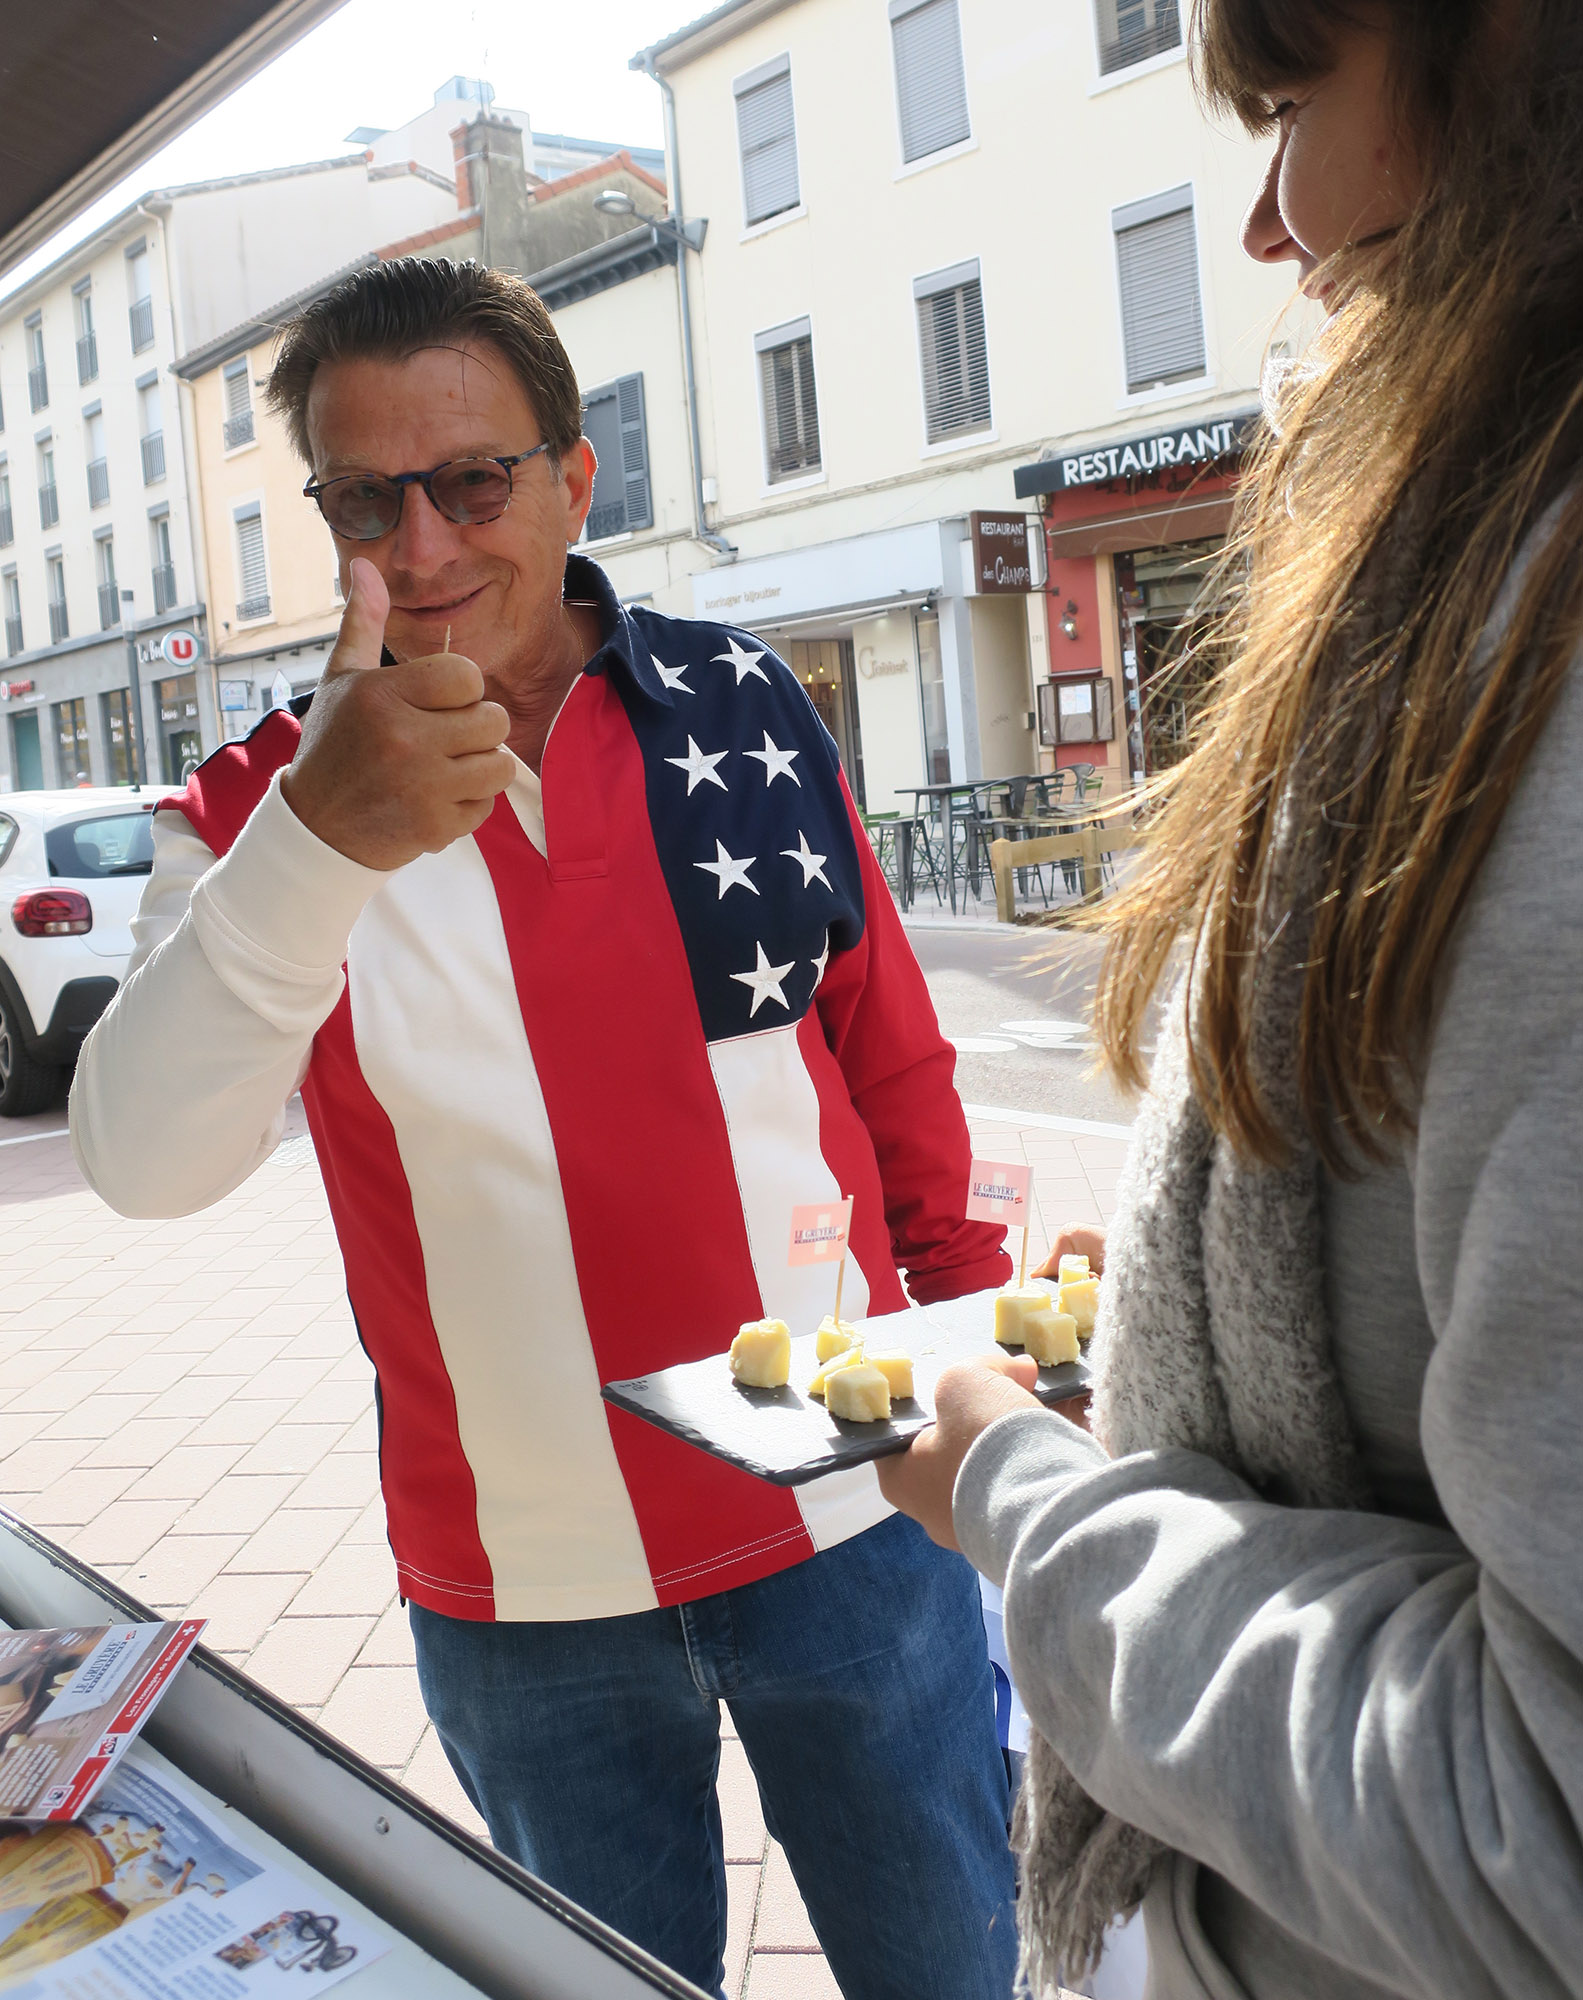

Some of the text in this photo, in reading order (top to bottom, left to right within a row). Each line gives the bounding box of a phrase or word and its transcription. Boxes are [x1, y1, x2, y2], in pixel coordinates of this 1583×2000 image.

[1062, 422, 1234, 486] RESTAURANT
[980, 521, 1025, 536] RESTAURANT
[983, 564, 995, 579] des
[743, 586, 781, 603] bijoutier
[171, 639, 193, 659] U
[973, 1182, 982, 1192] LE
[794, 1229, 803, 1240] LE
[71, 1682, 88, 1694] LE
[125, 1700, 139, 1718] Les
[135, 1671, 161, 1704] Fromages
